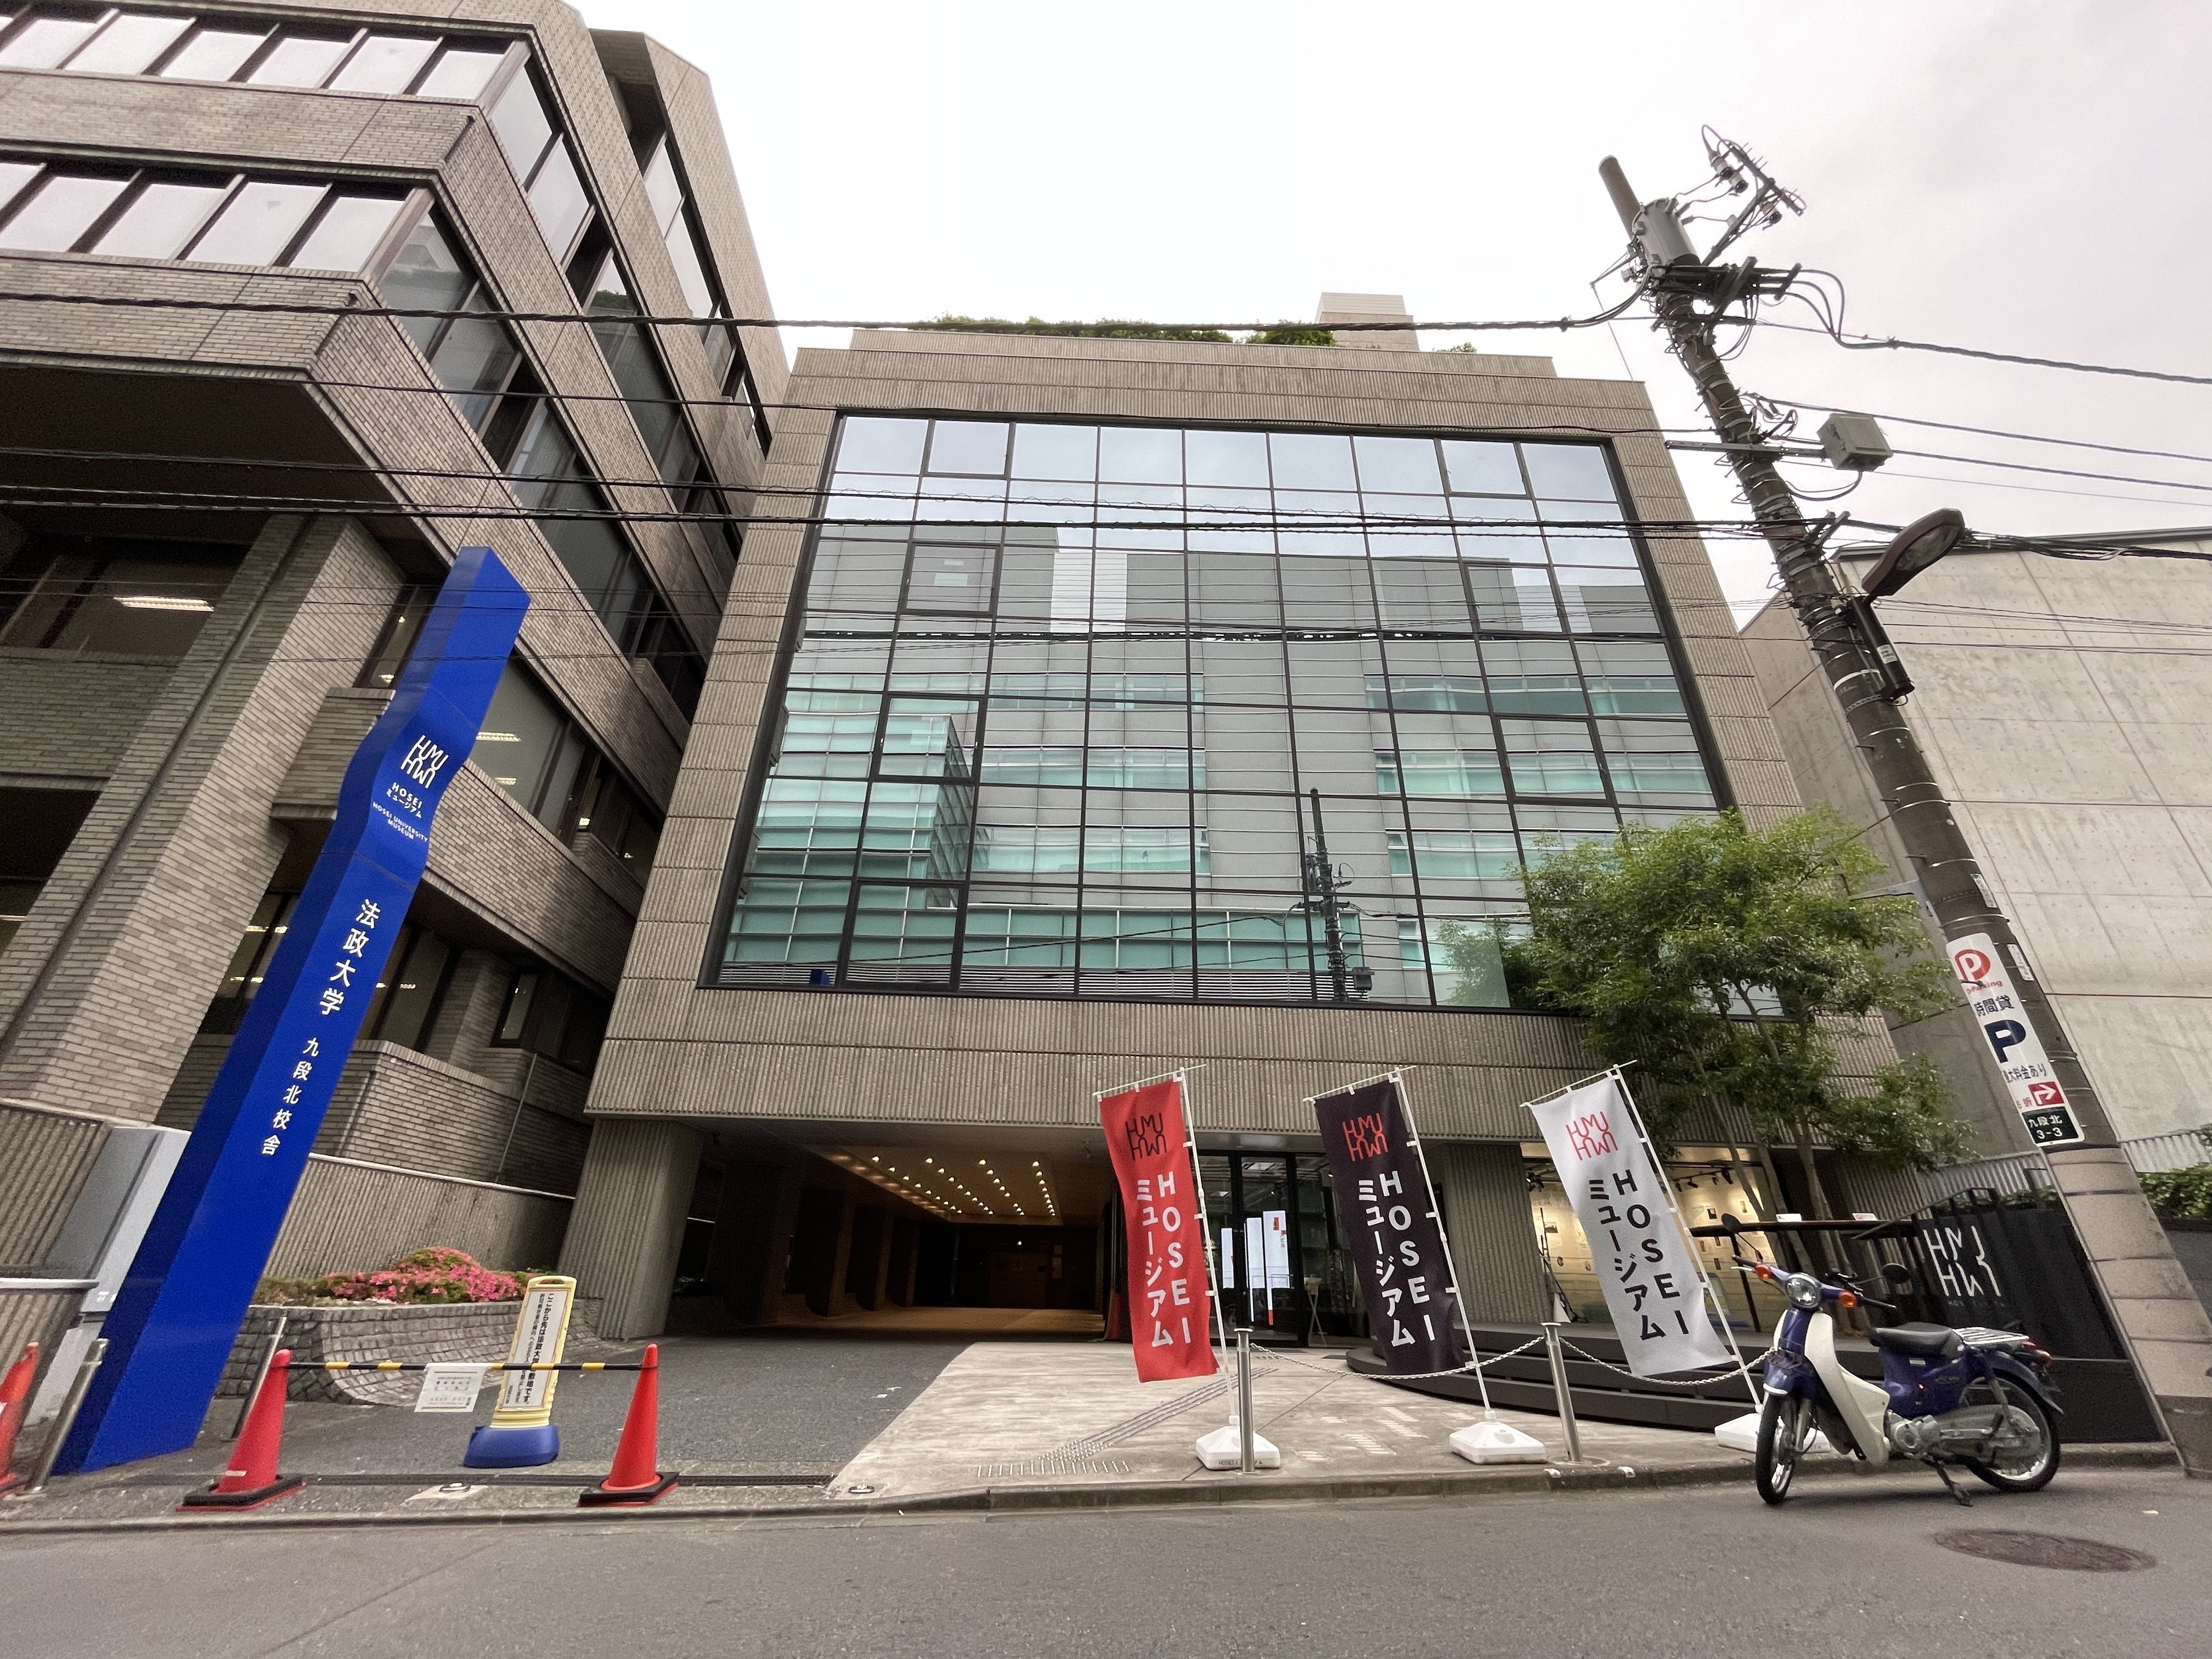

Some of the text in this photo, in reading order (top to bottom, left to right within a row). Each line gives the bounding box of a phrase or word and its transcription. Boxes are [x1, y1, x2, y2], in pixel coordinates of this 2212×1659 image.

[373, 802, 428, 842] HOSEI UNIVERSITY
[388, 819, 414, 840] MUSEUM
[392, 782, 422, 809] HOSEI
[261, 899, 382, 1156] 法政大学 九段北校舎
[1984, 1019, 2027, 1063] P
[2028, 1114, 2063, 1128] 九段北
[2036, 1127, 2063, 1139] 3-3
[1137, 1179, 1173, 1347] ミュージアム
[1158, 1171, 1191, 1344] HOSEI
[1358, 1180, 1415, 1347] ミュージアム
[1379, 1170, 1436, 1341] HOSEI
[1589, 1179, 1667, 1340] ミュージアム
[1612, 1169, 1689, 1335] HOSEI
